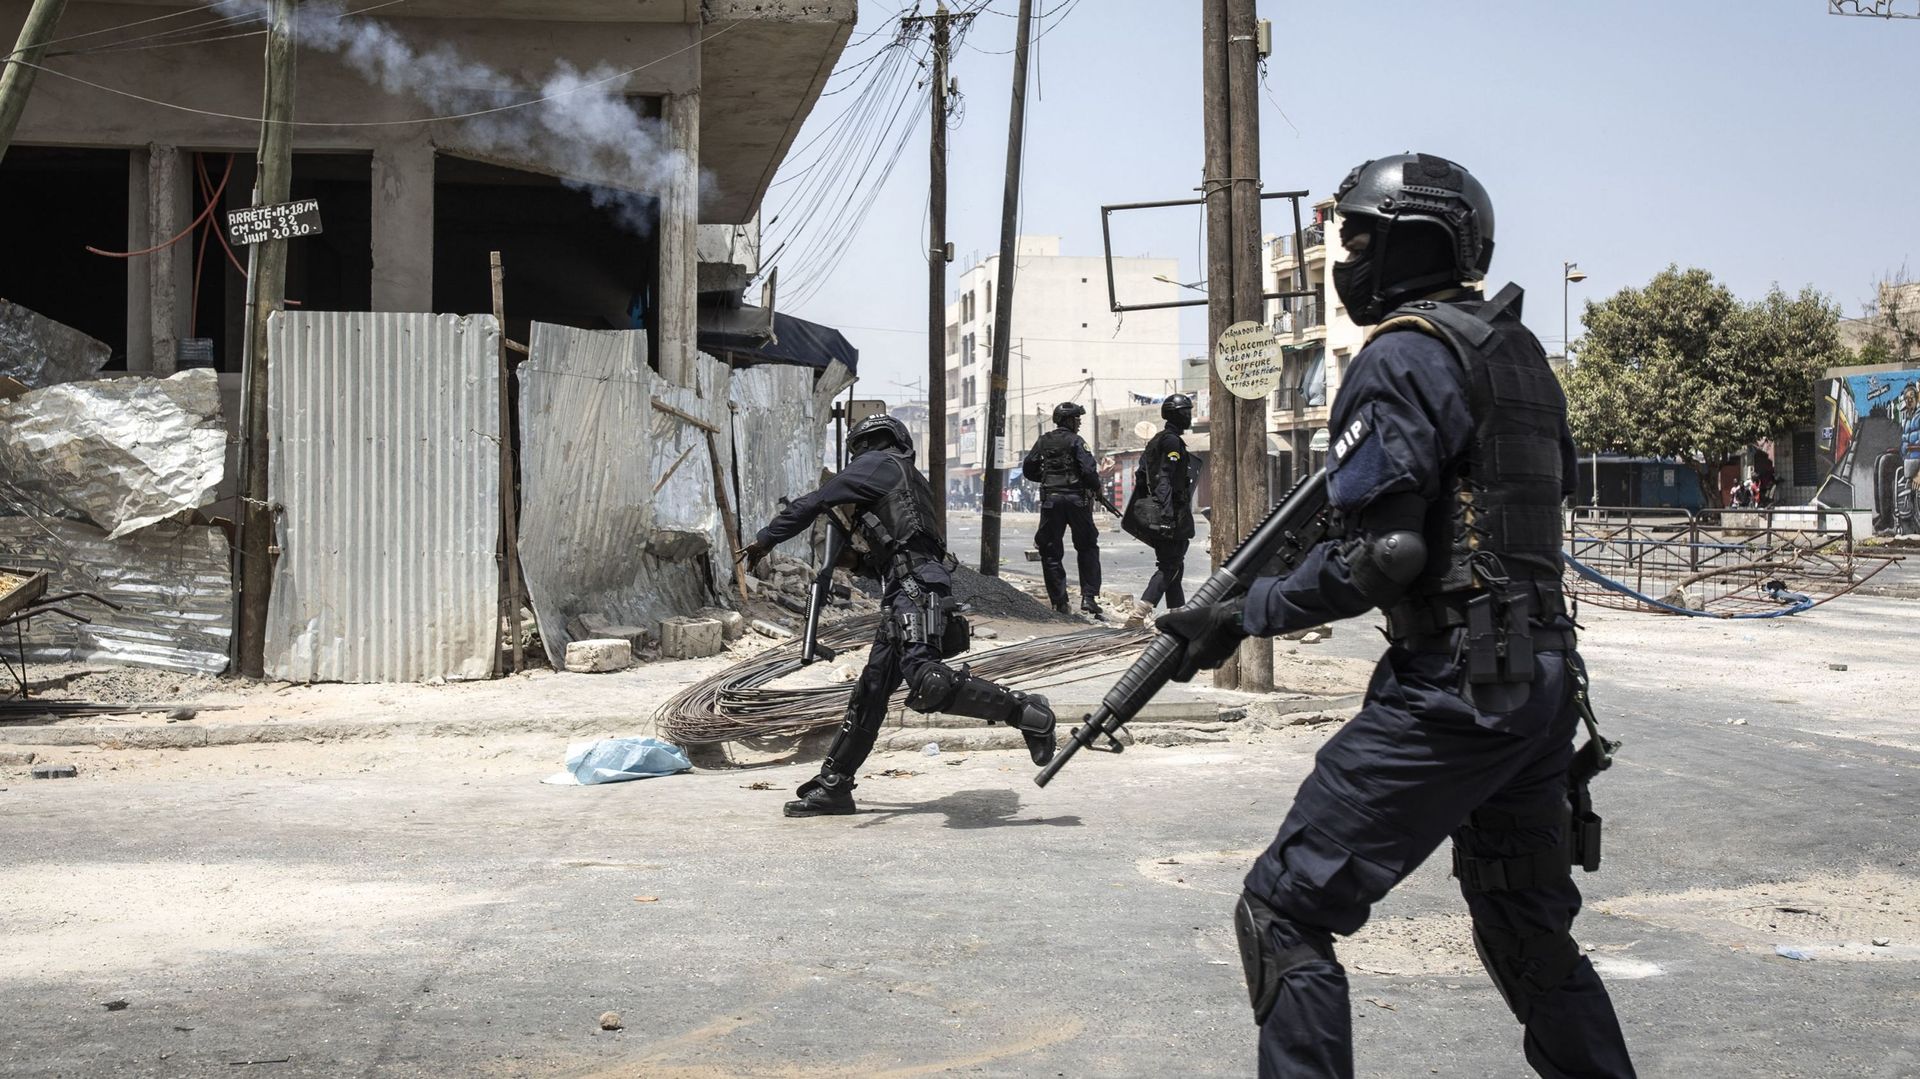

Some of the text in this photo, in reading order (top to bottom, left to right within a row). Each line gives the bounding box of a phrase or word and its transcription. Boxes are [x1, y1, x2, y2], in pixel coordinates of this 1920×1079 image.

[279, 215, 297, 227] 22
[1219, 337, 1277, 355] Déplacement
[1225, 349, 1263, 362] SALON DE
[1230, 358, 1271, 372] COIFFURE
[1334, 420, 1362, 459] BIP
